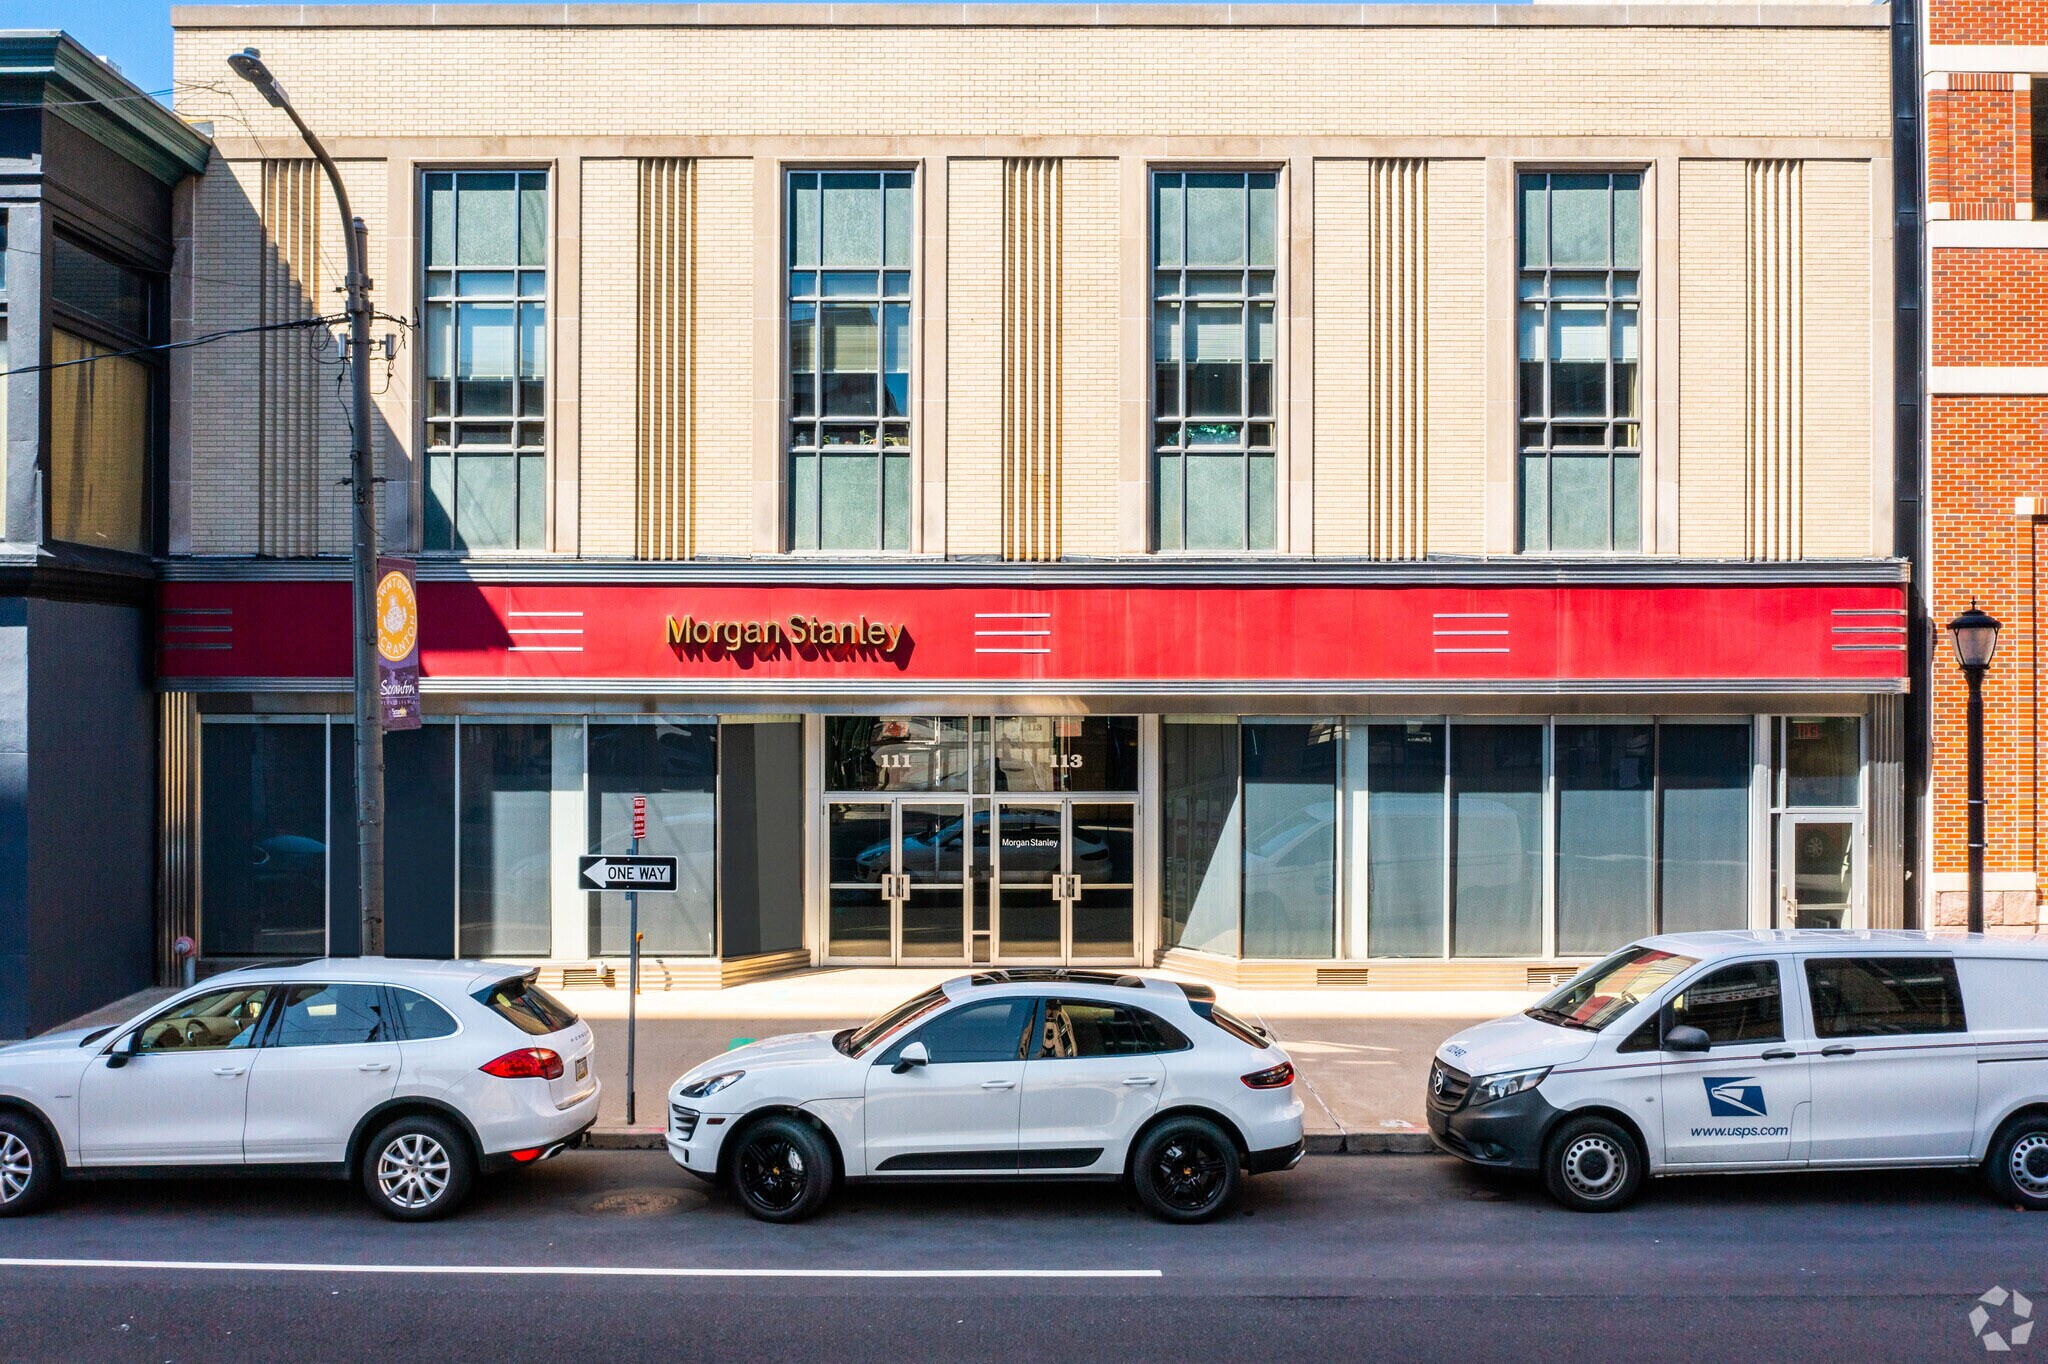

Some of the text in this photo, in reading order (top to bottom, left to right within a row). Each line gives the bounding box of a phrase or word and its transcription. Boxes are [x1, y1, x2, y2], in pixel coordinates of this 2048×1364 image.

[666, 614, 904, 652] Morgan Stanley
[380, 679, 415, 696] Scranton
[881, 754, 911, 768] 111
[1050, 754, 1083, 768] 113
[1002, 838, 1058, 849] Morgan Stanley
[608, 867, 666, 880] ONE WAY
[1691, 1126, 1788, 1139] www.usps.com
